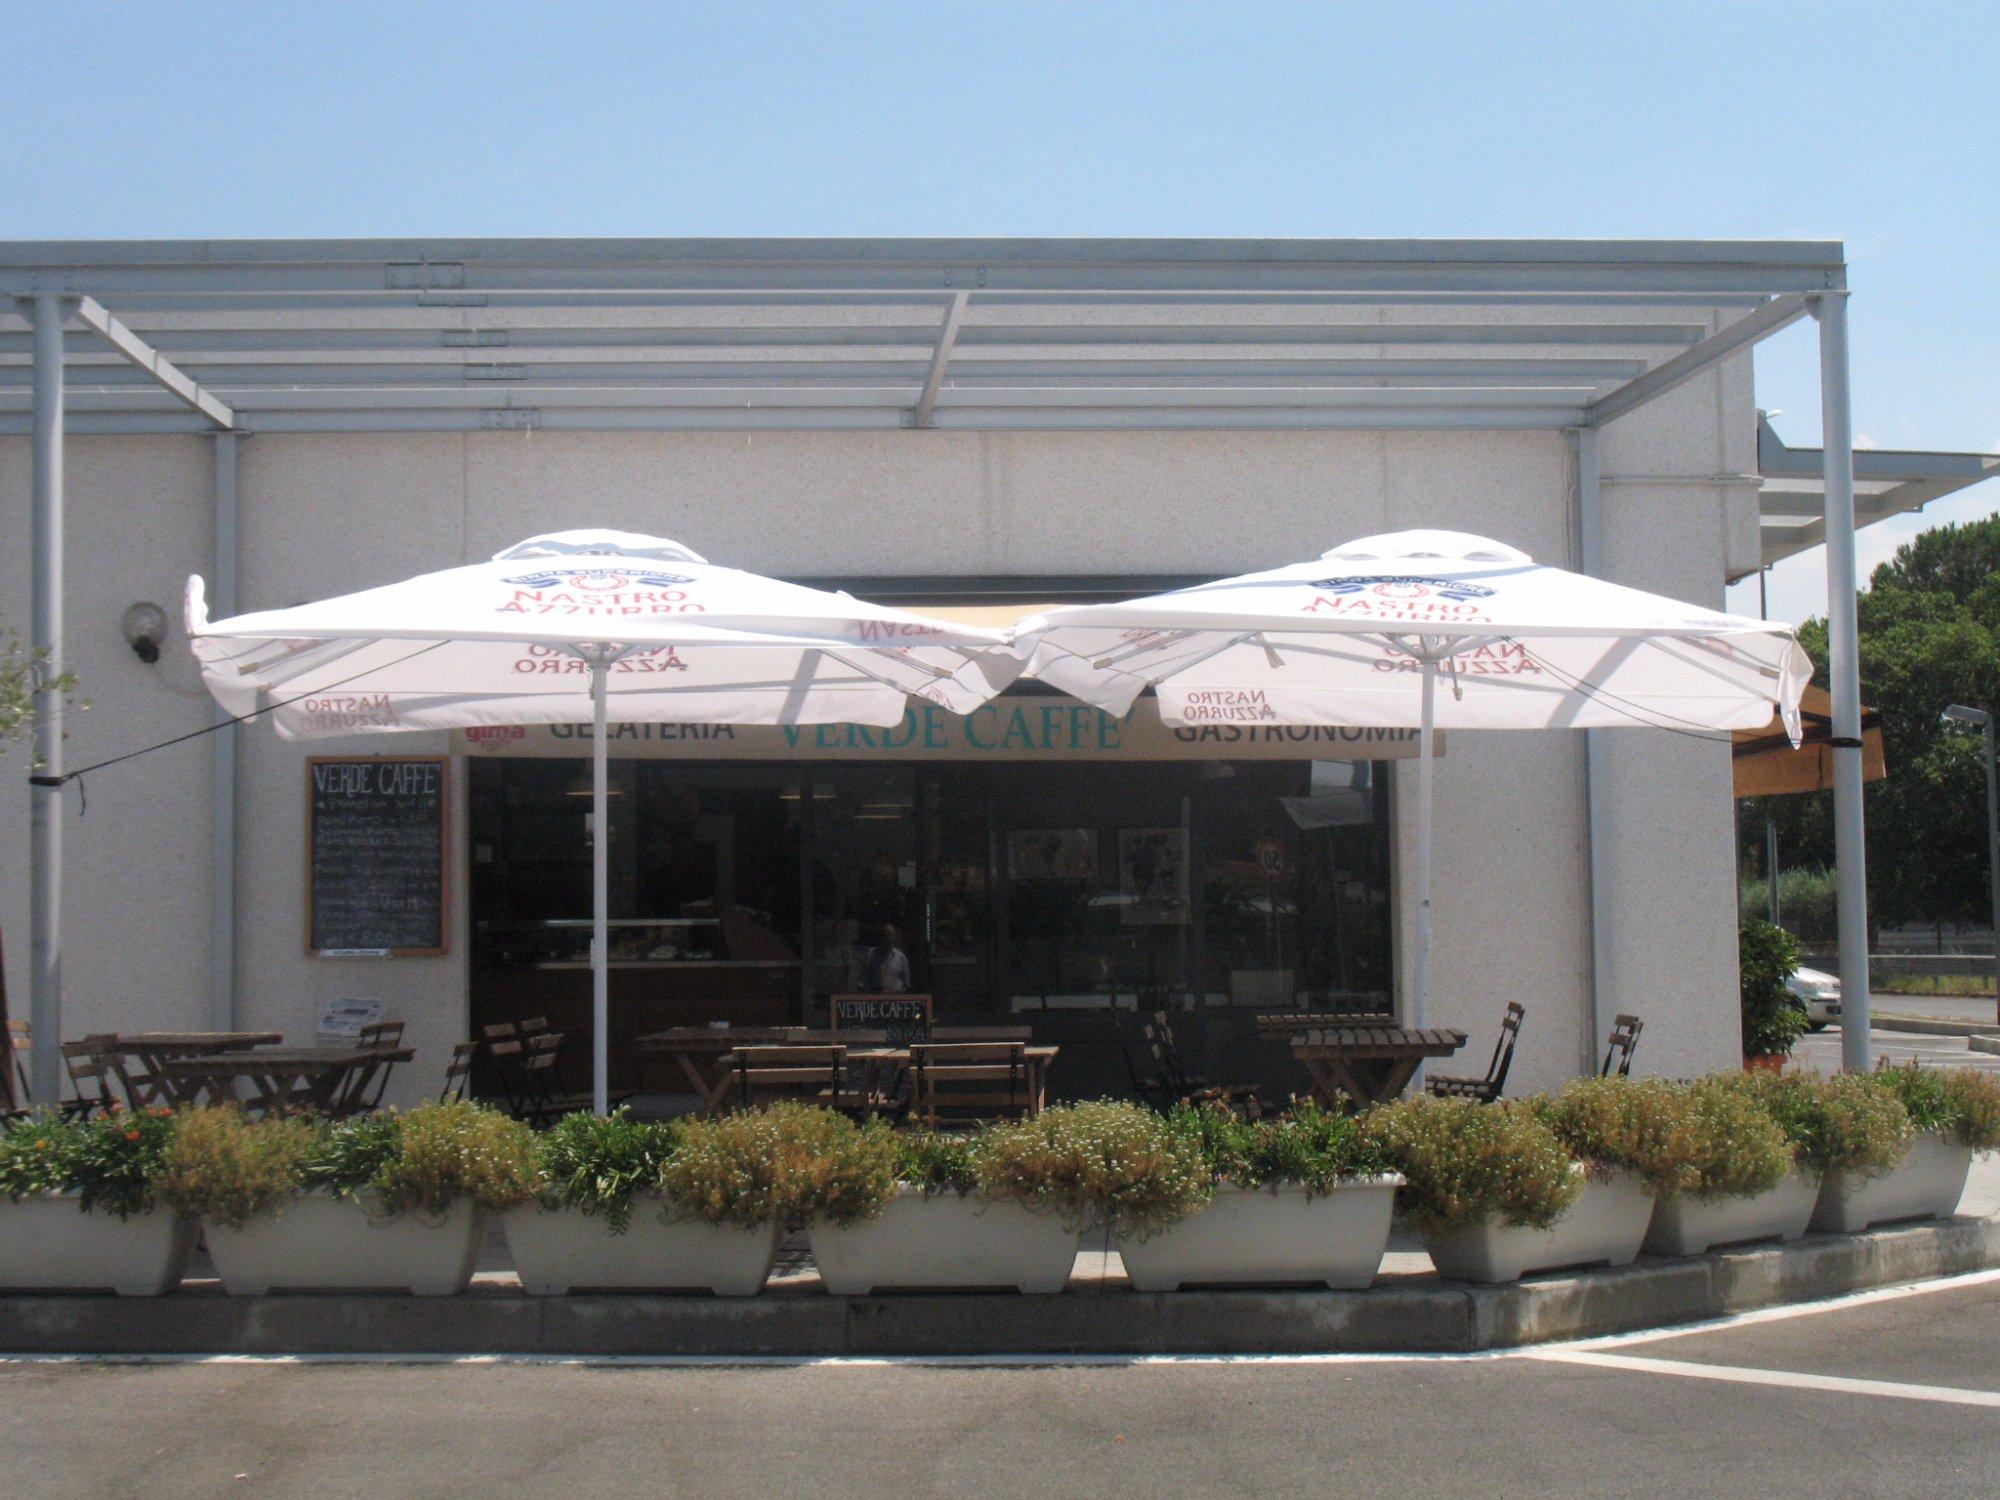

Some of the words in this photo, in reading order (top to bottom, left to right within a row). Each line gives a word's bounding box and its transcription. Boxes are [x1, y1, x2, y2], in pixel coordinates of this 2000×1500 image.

[514, 590, 687, 605] NASTRO
[1312, 596, 1479, 615] NASTRO
[550, 723, 736, 740] GEATERIA
[782, 705, 949, 749] VERDE
[313, 764, 373, 797] VERDE
[837, 1001, 879, 1020] VERDE
